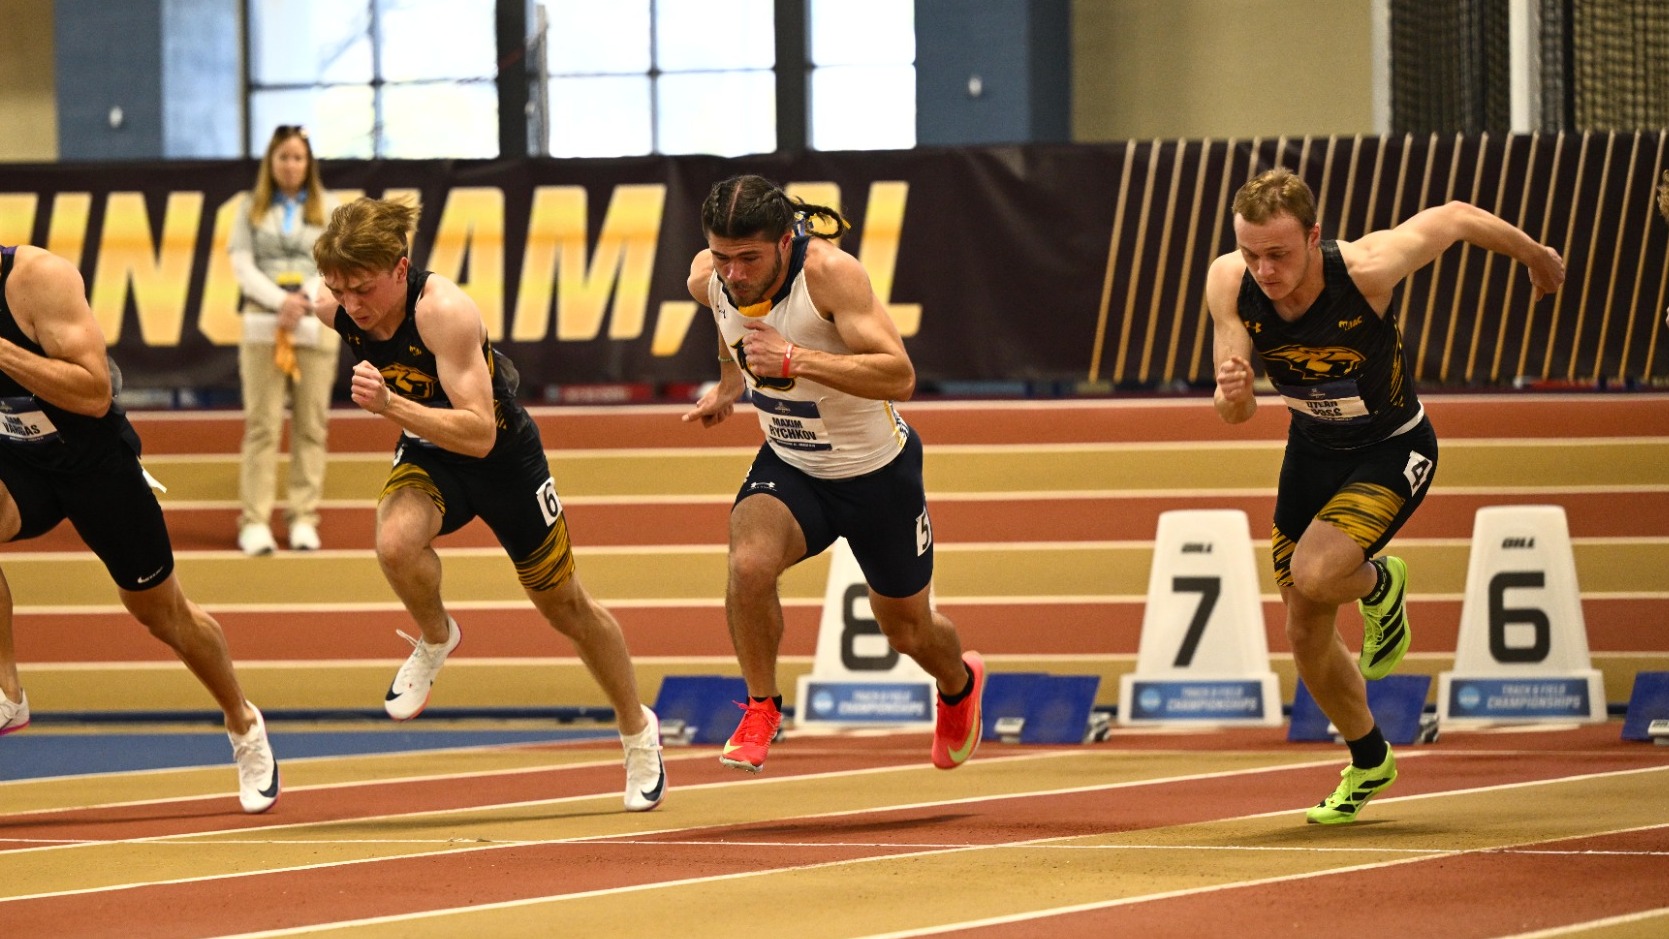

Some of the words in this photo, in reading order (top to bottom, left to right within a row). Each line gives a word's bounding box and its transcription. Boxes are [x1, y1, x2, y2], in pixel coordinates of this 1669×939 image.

[768, 425, 818, 440] RYCHKOV
[771, 416, 804, 429] MAXIM
[1410, 458, 1430, 489] 4
[542, 481, 559, 518] 6
[920, 509, 930, 551] 5
[840, 582, 901, 672] 8
[1172, 576, 1222, 668] 7
[1488, 571, 1551, 664] 6
[1487, 696, 1582, 710] CHAMPIONSHIPS
